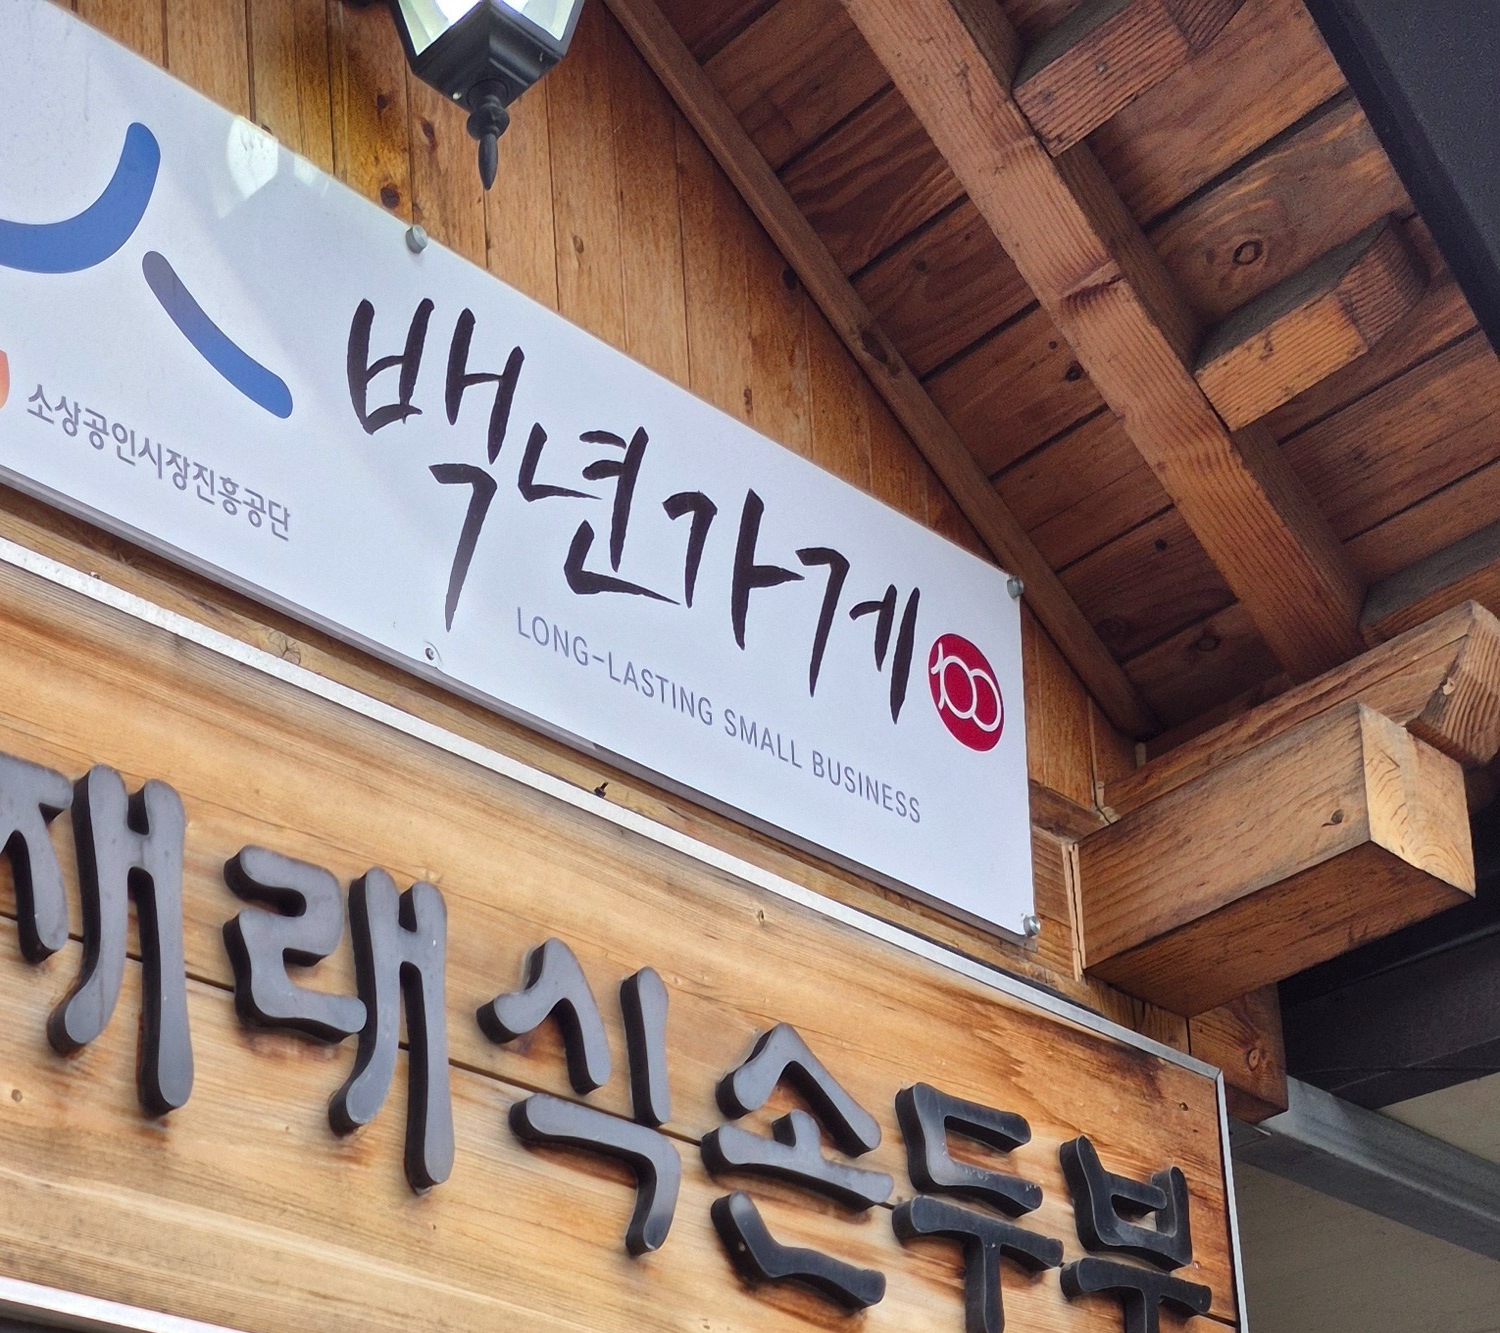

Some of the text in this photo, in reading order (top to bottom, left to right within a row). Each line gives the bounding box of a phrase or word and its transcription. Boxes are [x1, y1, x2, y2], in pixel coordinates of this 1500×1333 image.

[28, 384, 292, 540] 소상공인시장진흥공단
[347, 298, 921, 724] 백년가게
[517, 606, 922, 824] LONG-LASTING SMALL BUSINESS
